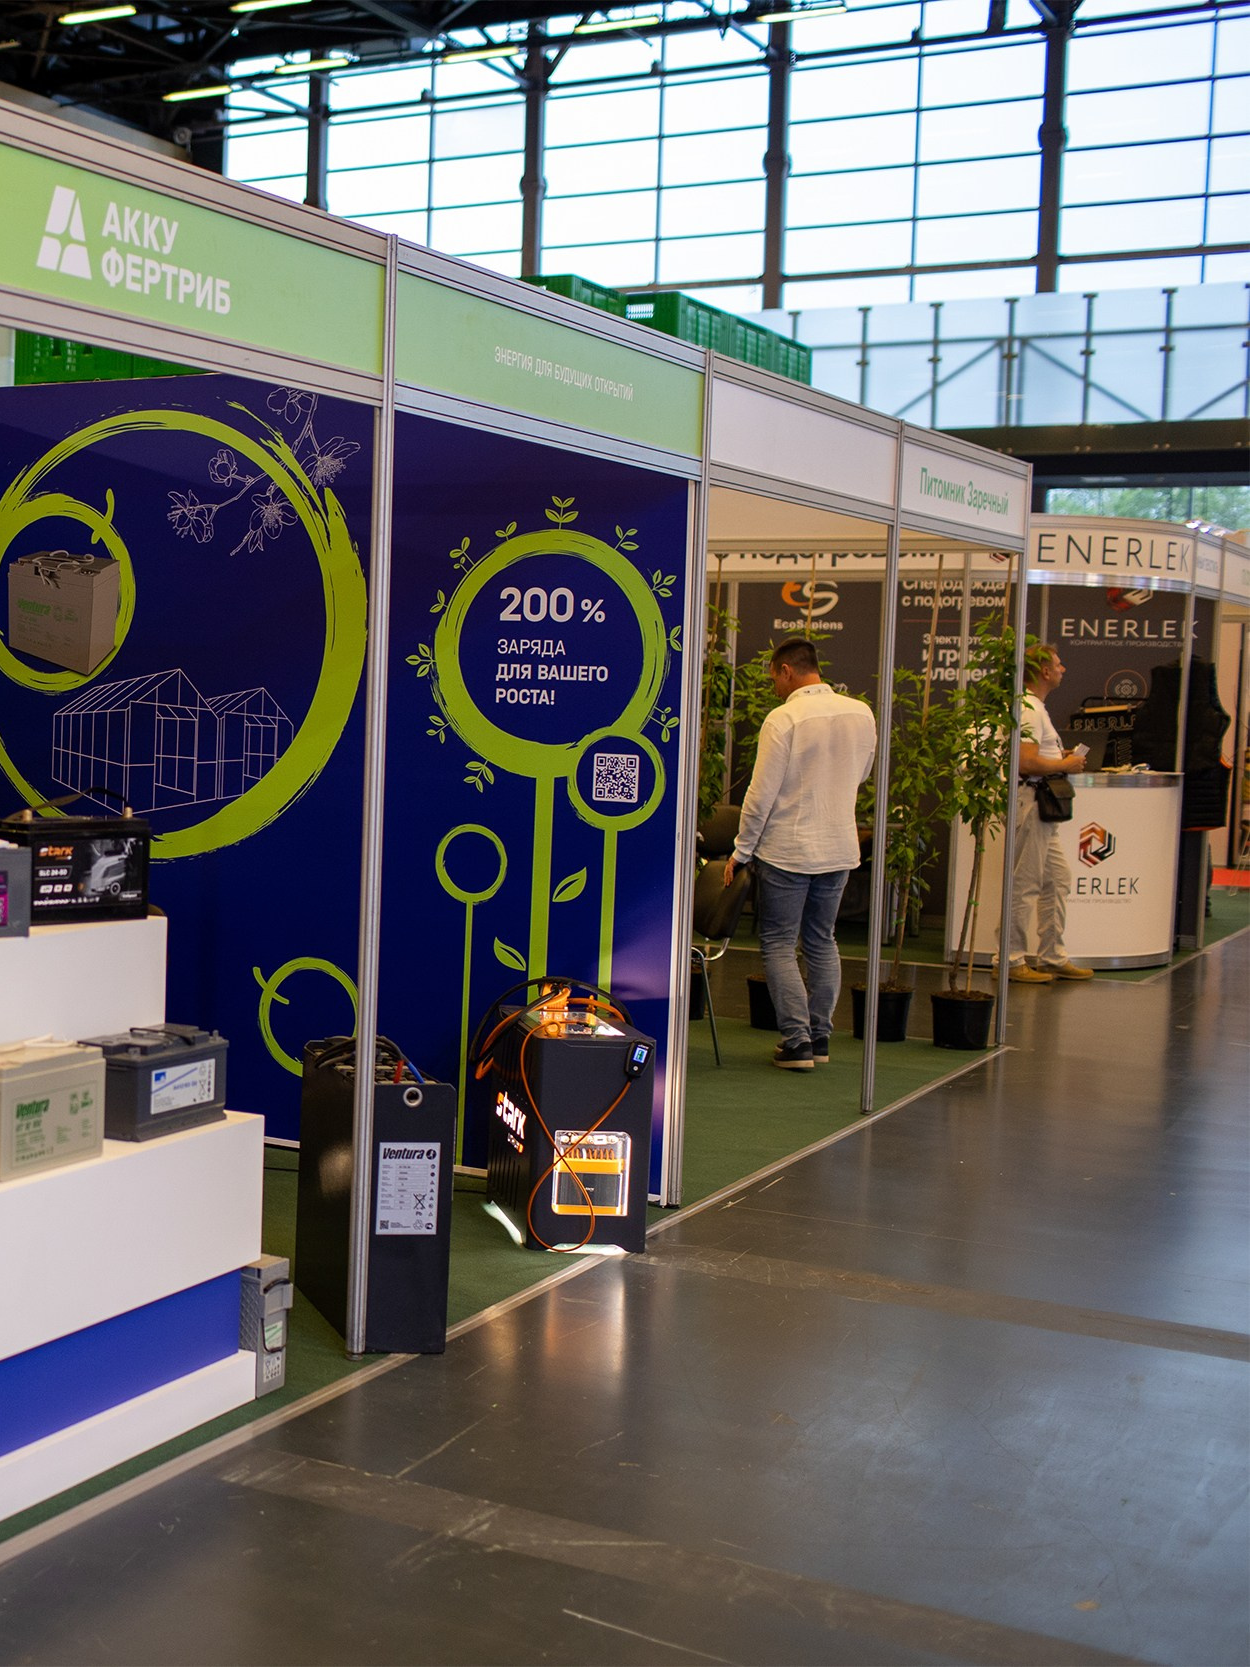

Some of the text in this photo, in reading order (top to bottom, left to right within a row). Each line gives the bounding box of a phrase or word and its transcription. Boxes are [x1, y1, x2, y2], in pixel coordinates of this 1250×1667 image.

[102, 201, 179, 255] АККУ
[102, 246, 231, 315] ФЕРТРИБ
[494, 345, 634, 401] ЭНЕРГИЯ ДЛЯ БУДУЩИХ ОТКРЫТИЙ
[920, 466, 1009, 516] Питомник Заречный
[1037, 533, 1191, 573] ENERLEK
[499, 586, 606, 623] 200 %
[902, 596, 911, 607] с
[497, 638, 566, 658] ЗАРЯДА
[495, 663, 609, 682] ДЛЯ ВАШЕГО
[495, 688, 555, 705] РОСТА!
[1076, 877, 1139, 895] ERLEK
[496, 1091, 526, 1140] stark
[382, 1148, 425, 1160] Ventura
